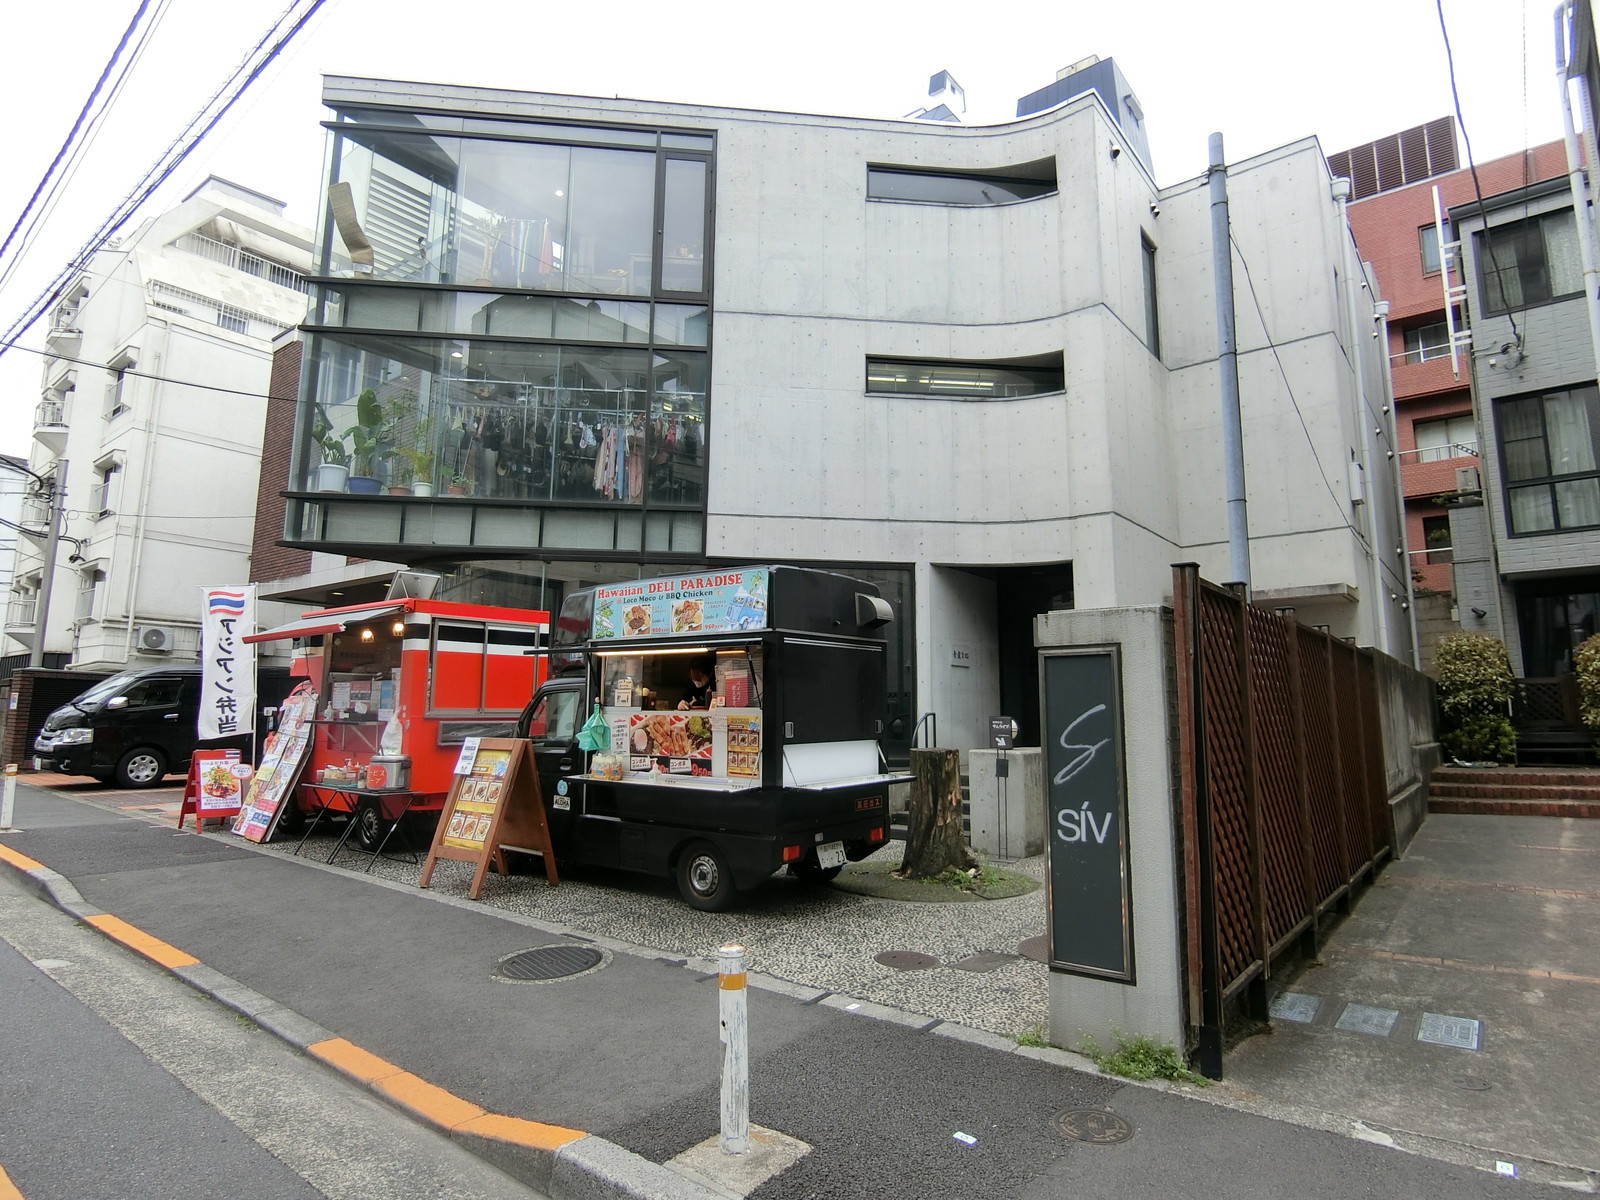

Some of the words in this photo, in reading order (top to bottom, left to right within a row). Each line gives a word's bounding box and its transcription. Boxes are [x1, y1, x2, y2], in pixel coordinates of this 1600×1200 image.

[597, 586, 643, 599] Hawaiian
[648, 580, 675, 594] DELI
[680, 573, 743, 590] PARADISE
[666, 591, 681, 599] BBQ
[683, 590, 713, 598] Chicken
[368, 769, 386, 777] ービス
[555, 798, 570, 807] ALOHA
